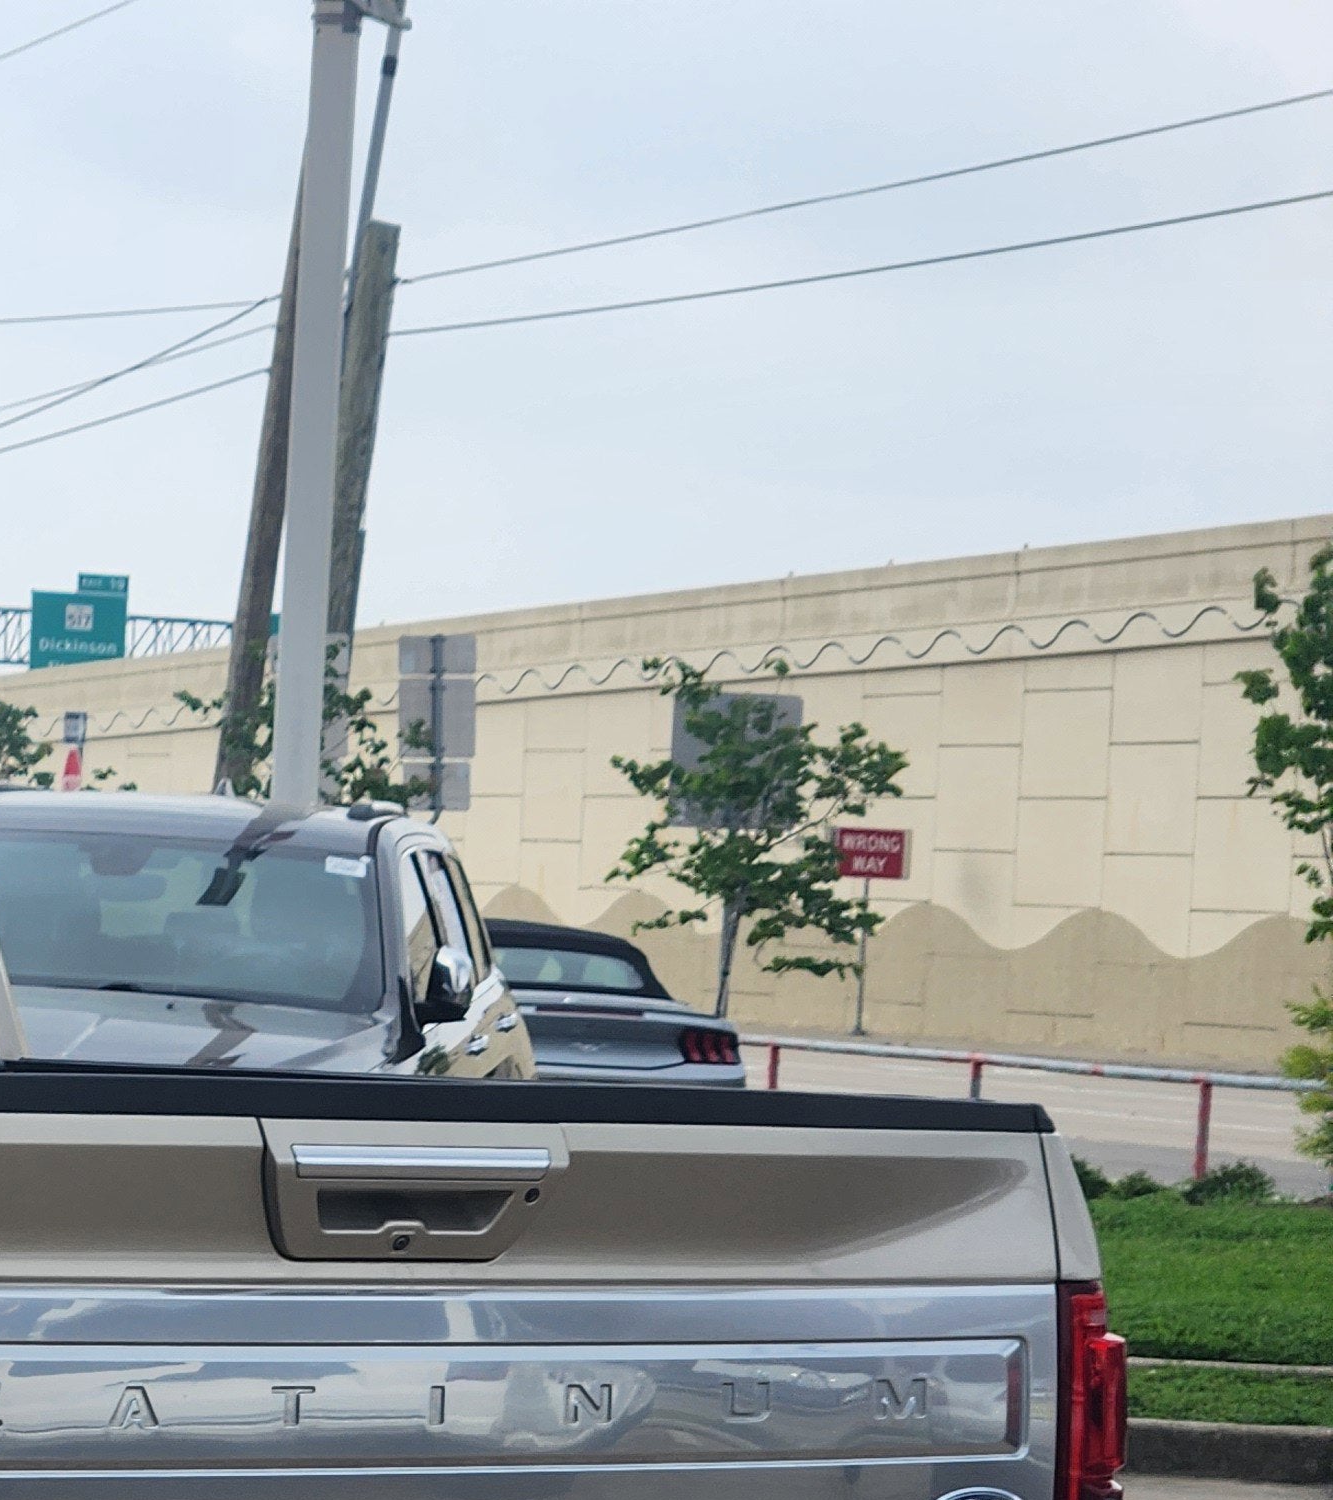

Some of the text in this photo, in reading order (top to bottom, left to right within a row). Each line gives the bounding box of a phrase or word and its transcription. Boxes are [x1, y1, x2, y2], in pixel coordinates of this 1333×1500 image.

[38, 637, 118, 655] Dickinson
[841, 831, 901, 853] WRONG
[852, 855, 888, 873] WAY
